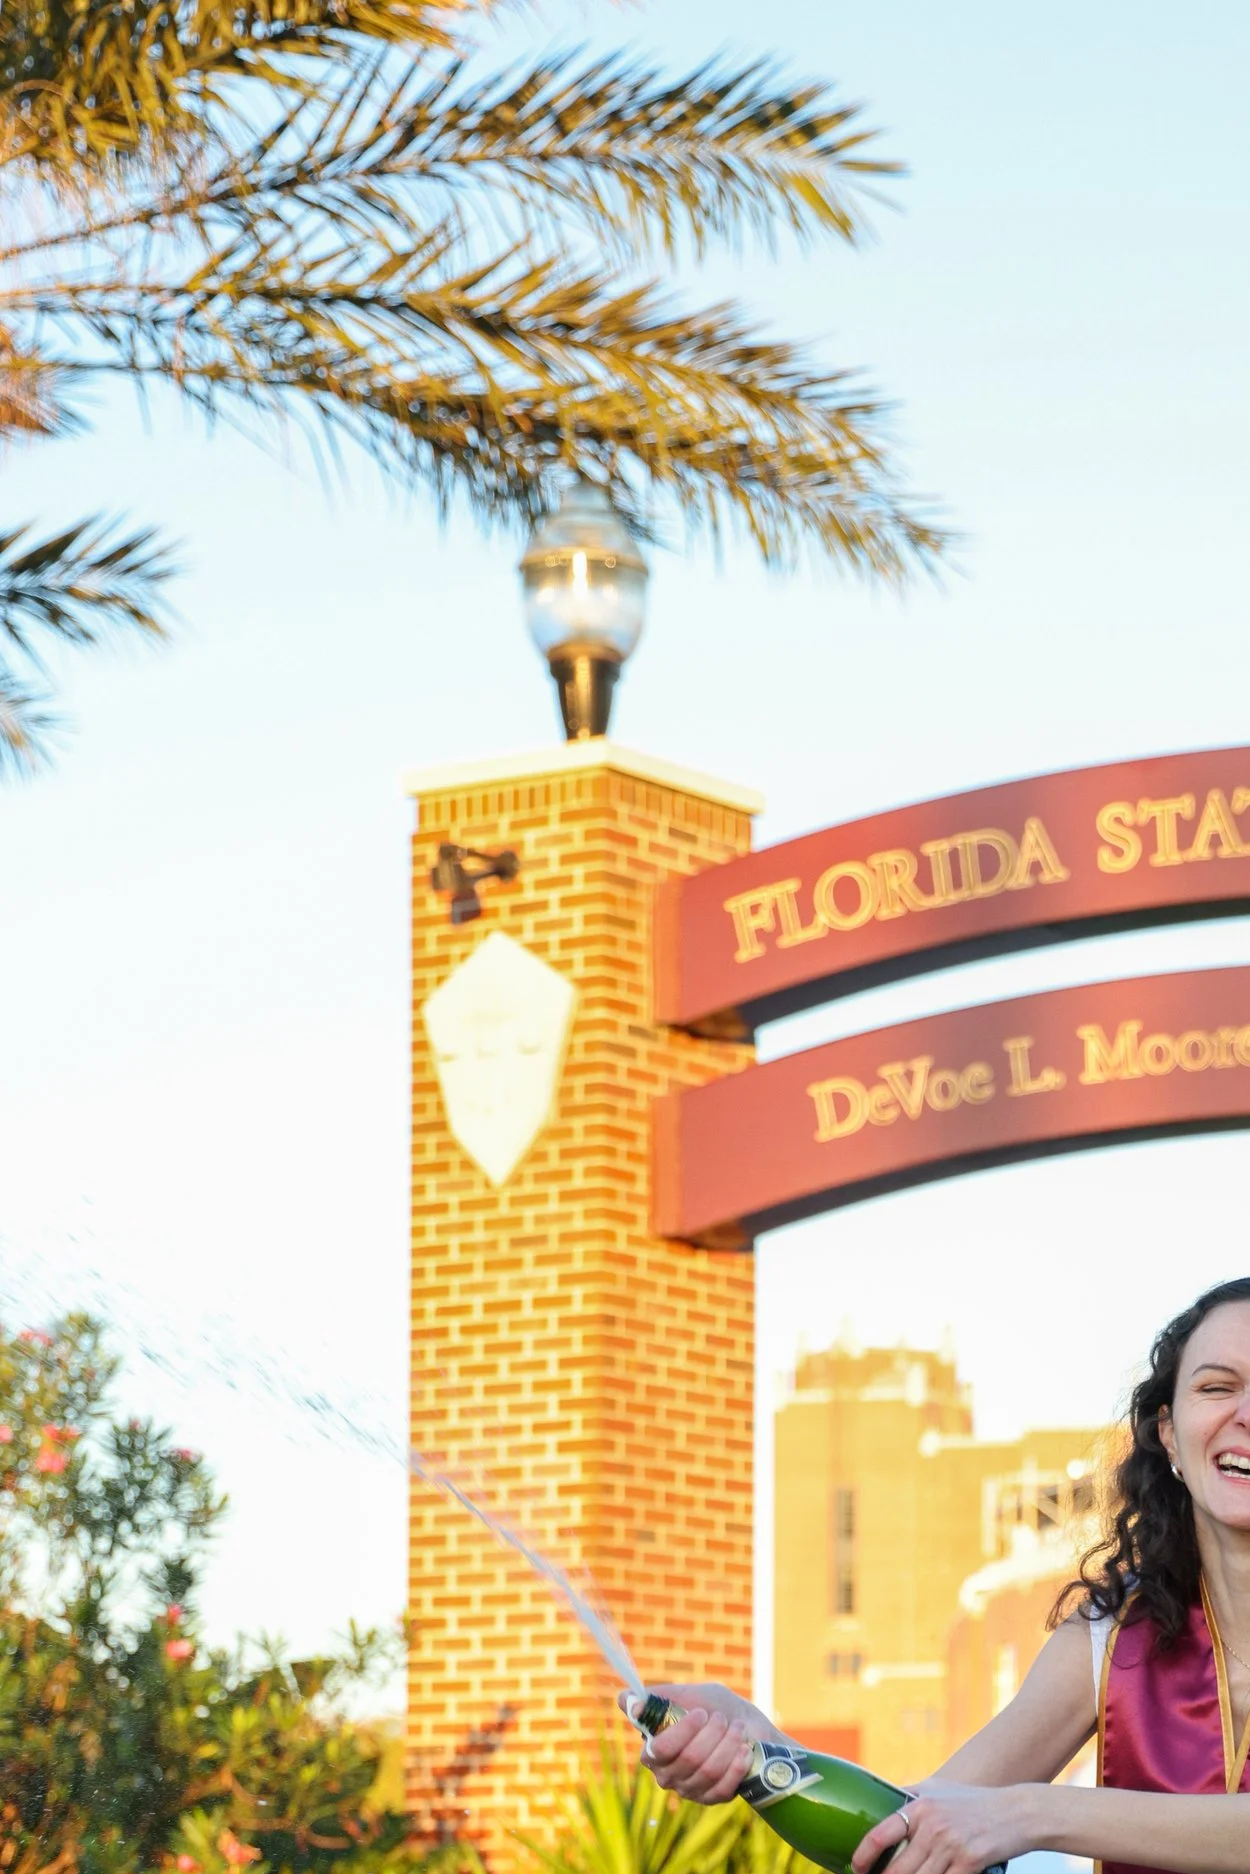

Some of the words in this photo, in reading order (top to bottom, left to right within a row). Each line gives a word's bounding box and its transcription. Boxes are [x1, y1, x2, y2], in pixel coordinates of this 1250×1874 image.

[724, 817, 1069, 963] FLORIDA
[807, 1056, 994, 1142] DeVoe
[1004, 1037, 1067, 1097] L.
